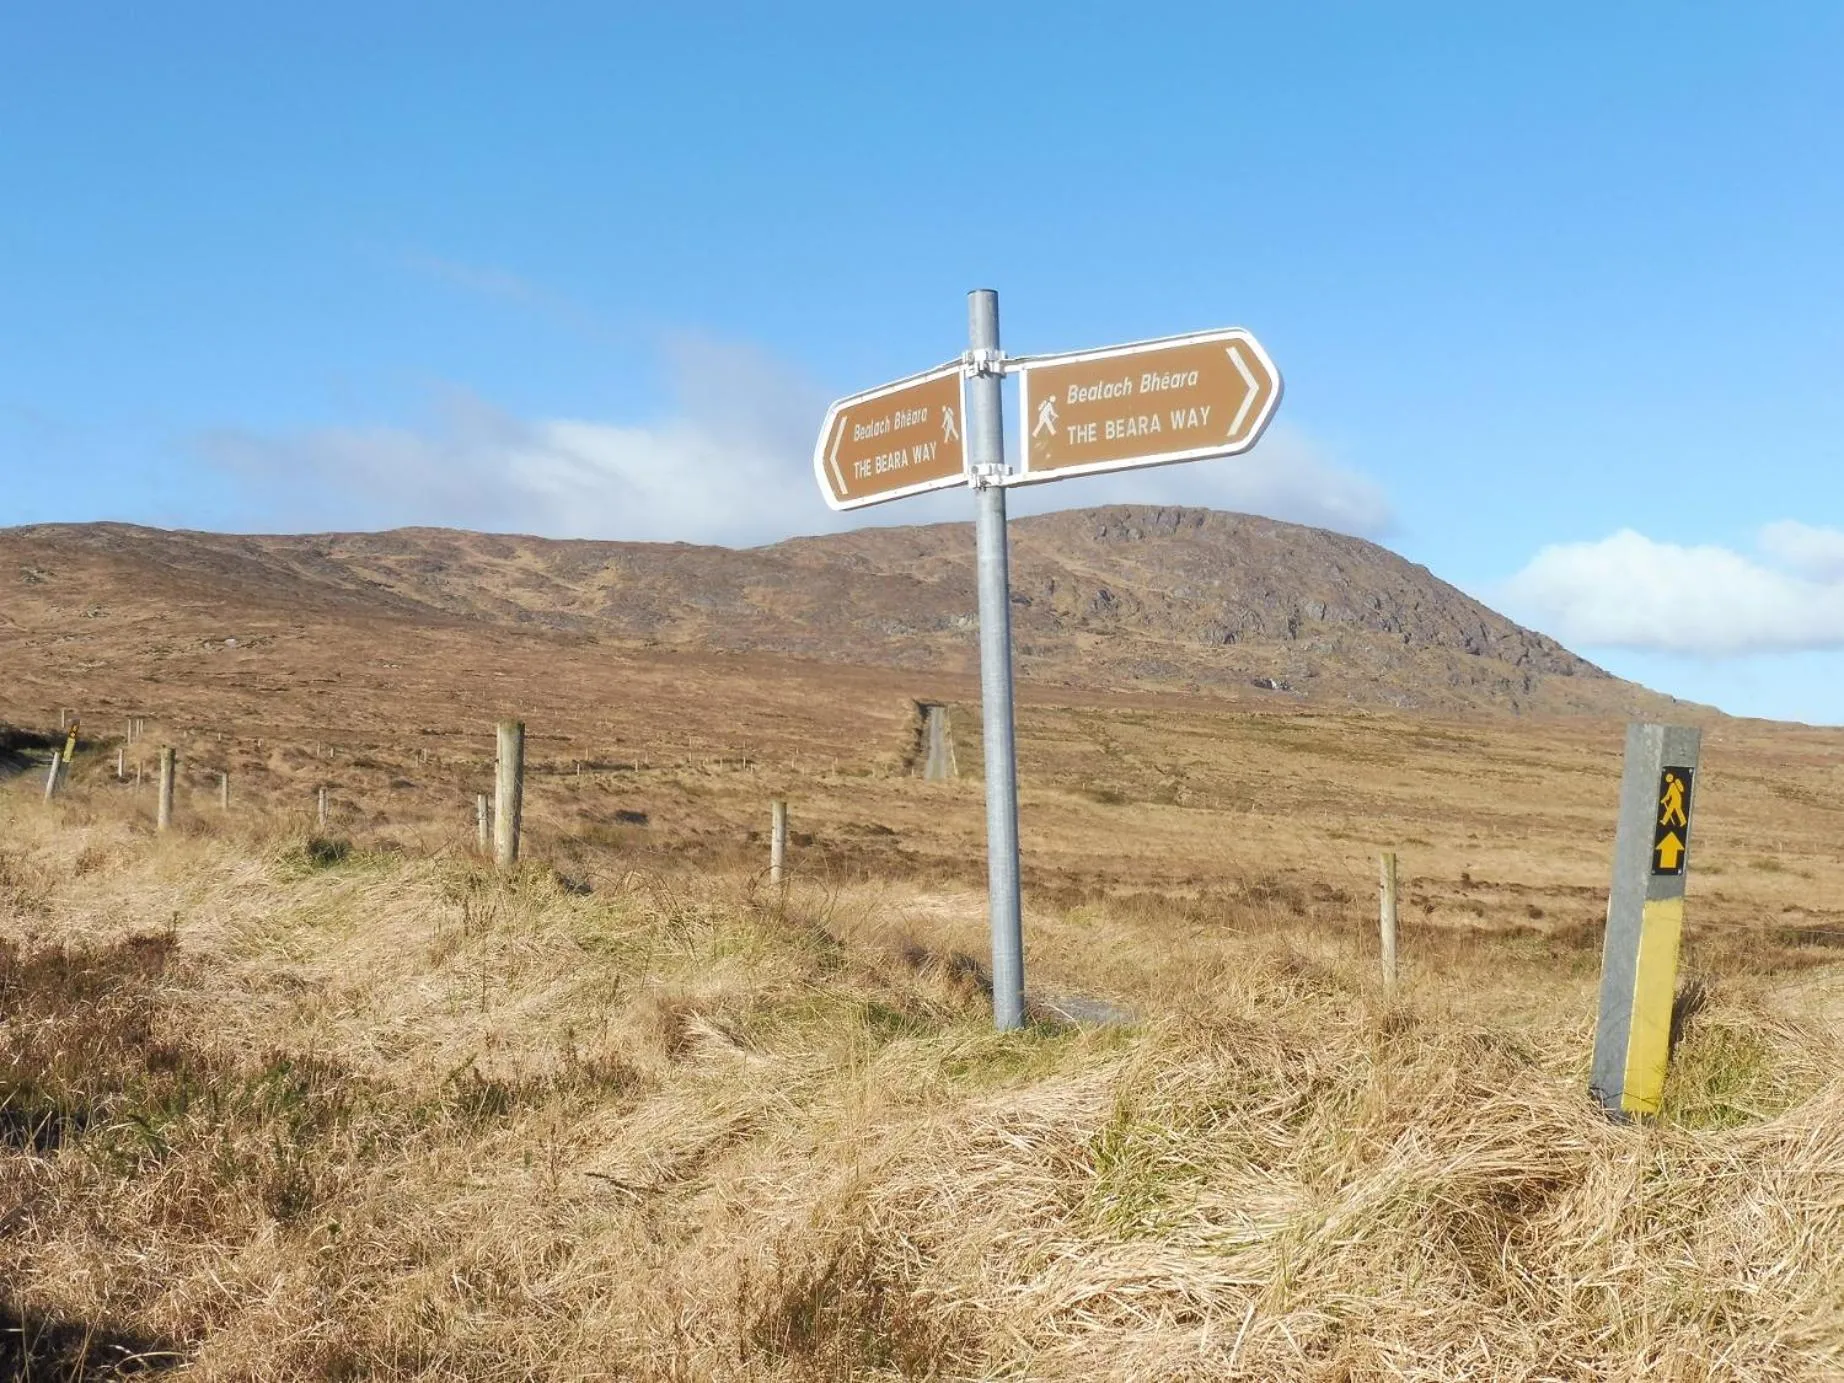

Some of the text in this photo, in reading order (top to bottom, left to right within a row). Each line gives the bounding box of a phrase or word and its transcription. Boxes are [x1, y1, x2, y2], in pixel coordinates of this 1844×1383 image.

[1067, 376, 1132, 404] Bealach
[854, 416, 891, 441] Bealach
[1067, 406, 1211, 445] THE BEARA WAY
[854, 441, 937, 479] THE BEARA WAY
